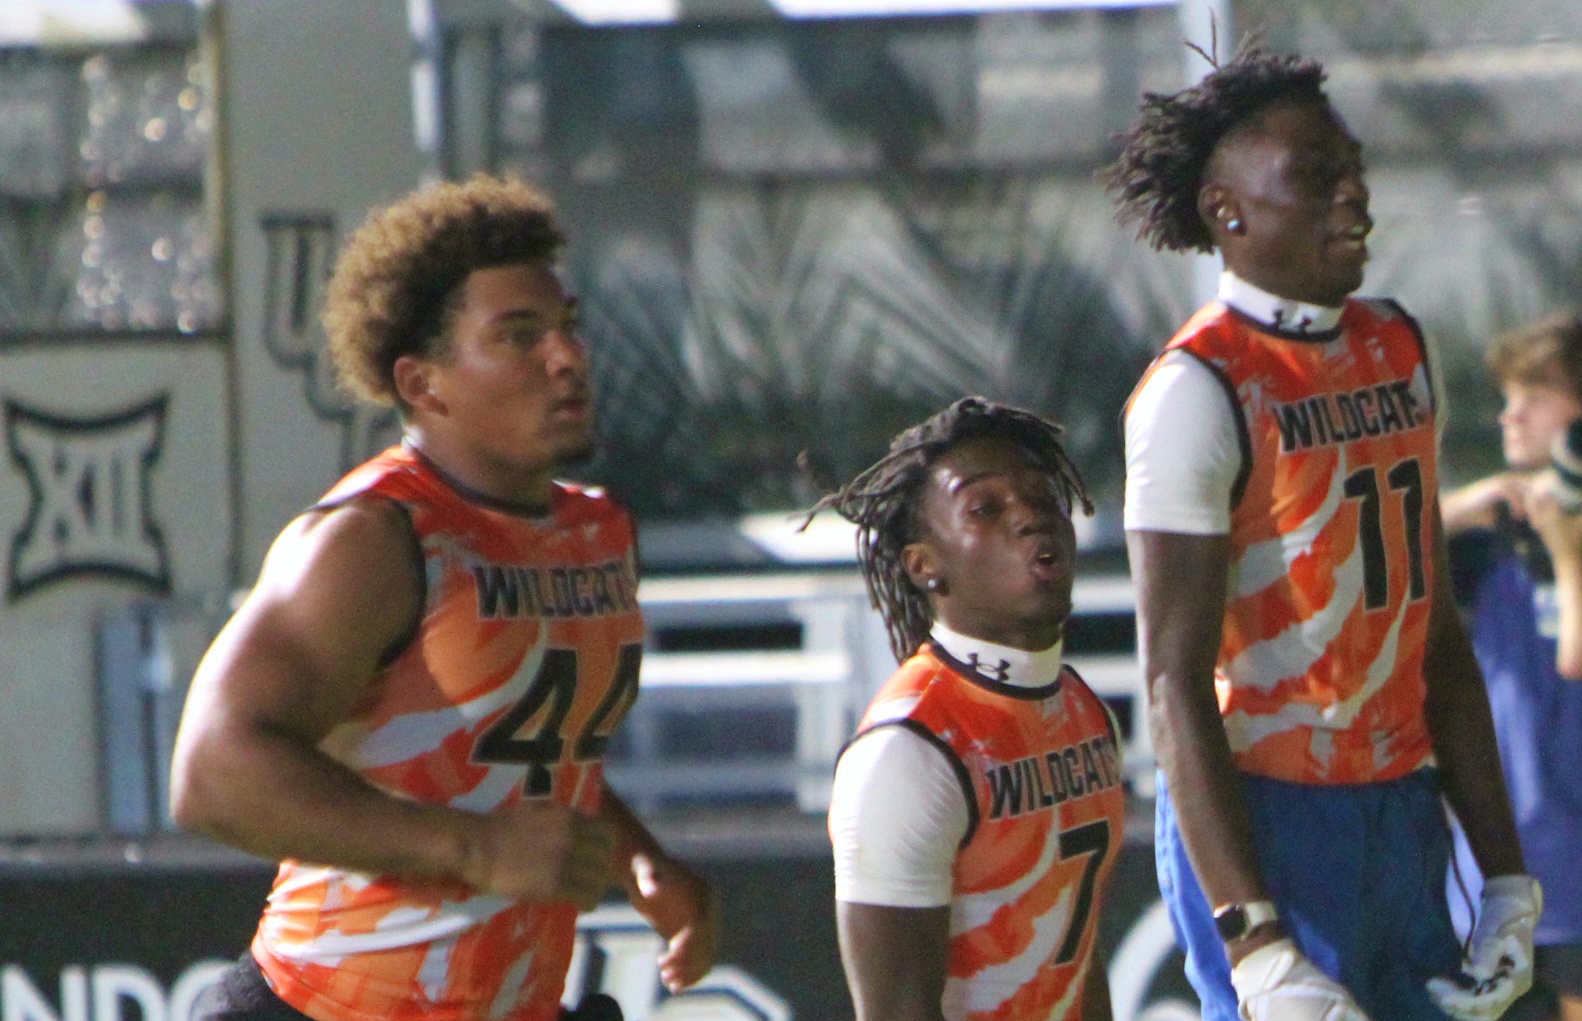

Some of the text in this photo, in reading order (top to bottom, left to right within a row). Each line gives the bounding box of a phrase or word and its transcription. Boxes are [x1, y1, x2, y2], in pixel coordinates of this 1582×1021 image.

[1272, 377, 1432, 453] WILDCAT
[471, 561, 632, 620] WILDCAT
[1342, 457, 1426, 614] 11
[466, 642, 643, 799] 44
[986, 734, 1122, 821] WILDCAT
[1050, 818, 1110, 966] 7
